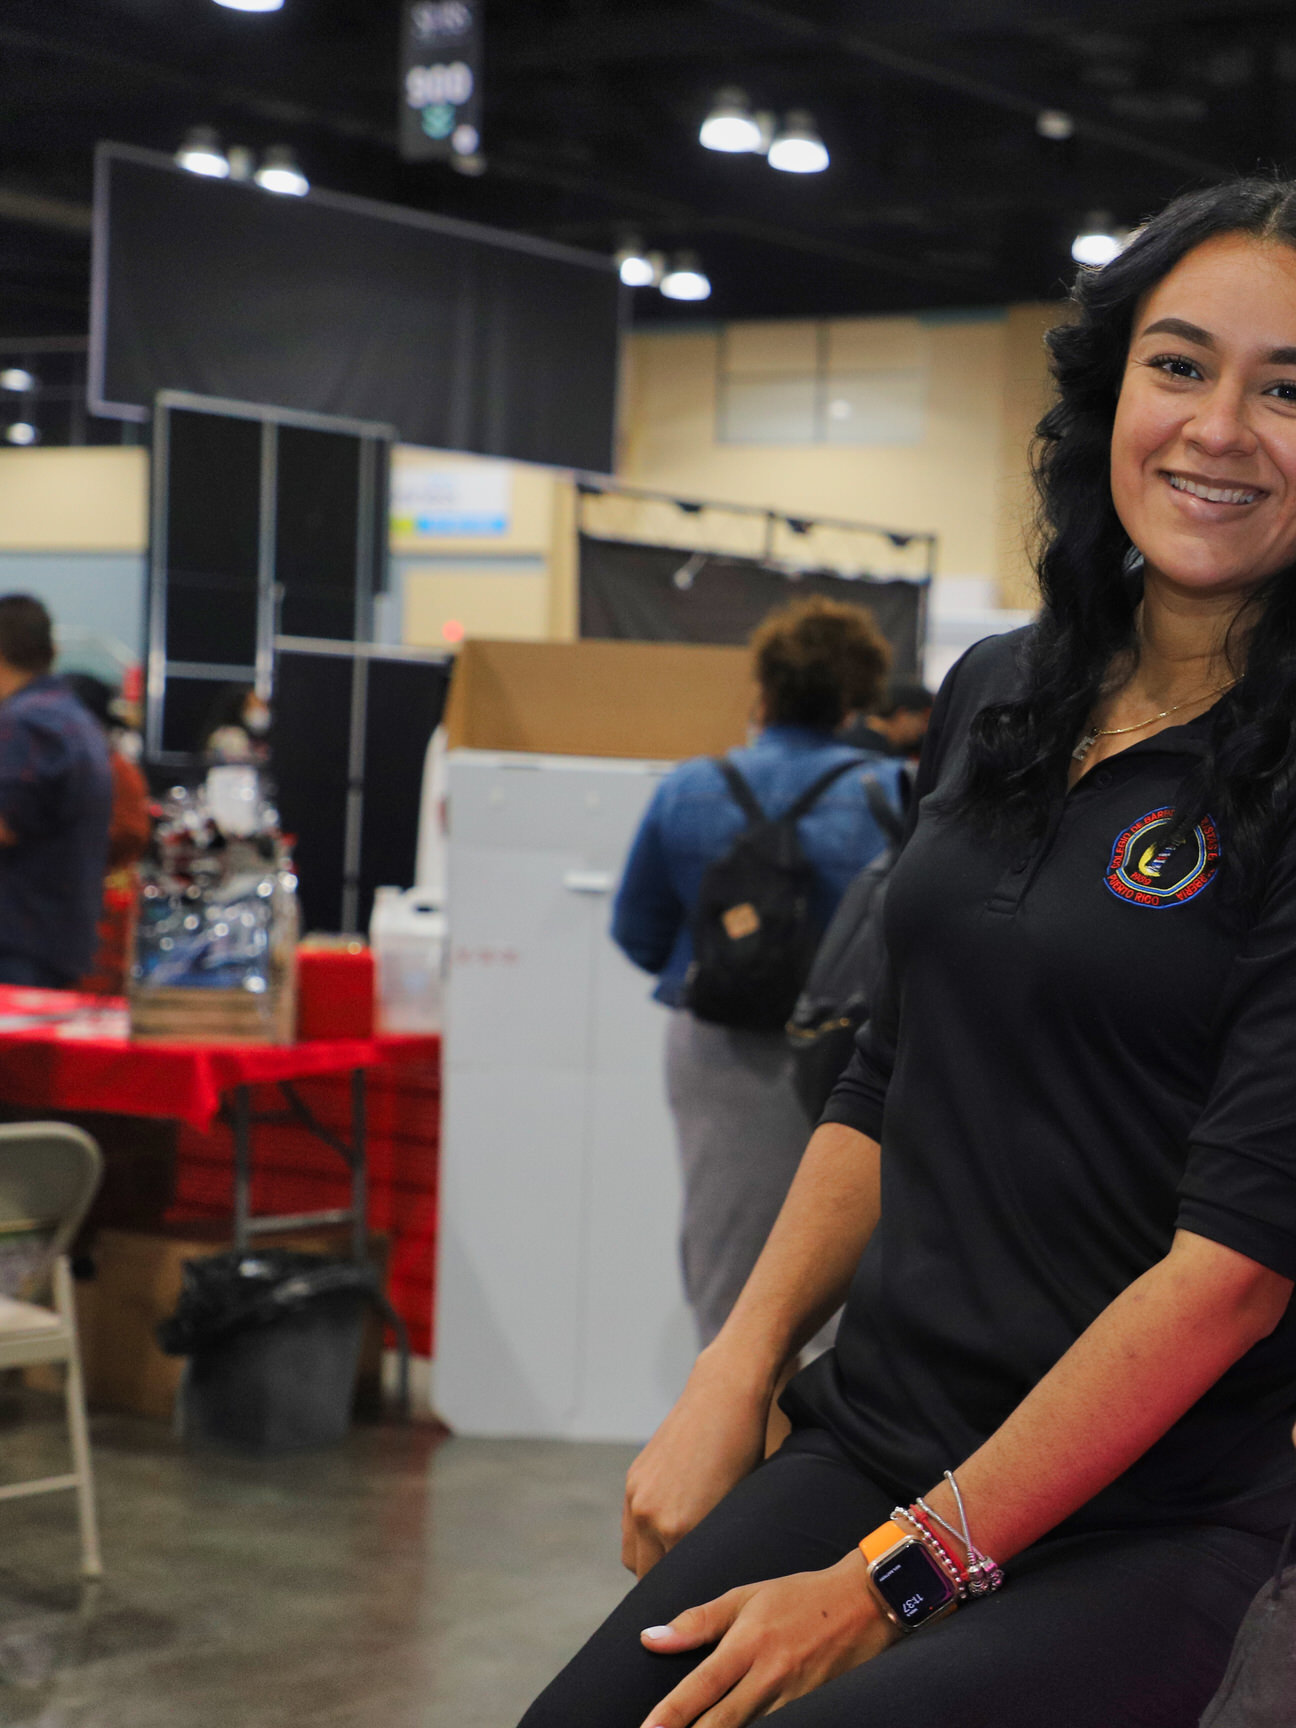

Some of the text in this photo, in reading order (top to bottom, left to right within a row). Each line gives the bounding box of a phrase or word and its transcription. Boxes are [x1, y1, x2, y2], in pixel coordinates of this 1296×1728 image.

[1110, 832, 1132, 869] COLEGIO
[1108, 874, 1159, 905] PUERTO RICO
[902, 1593, 924, 1613] 11:37
